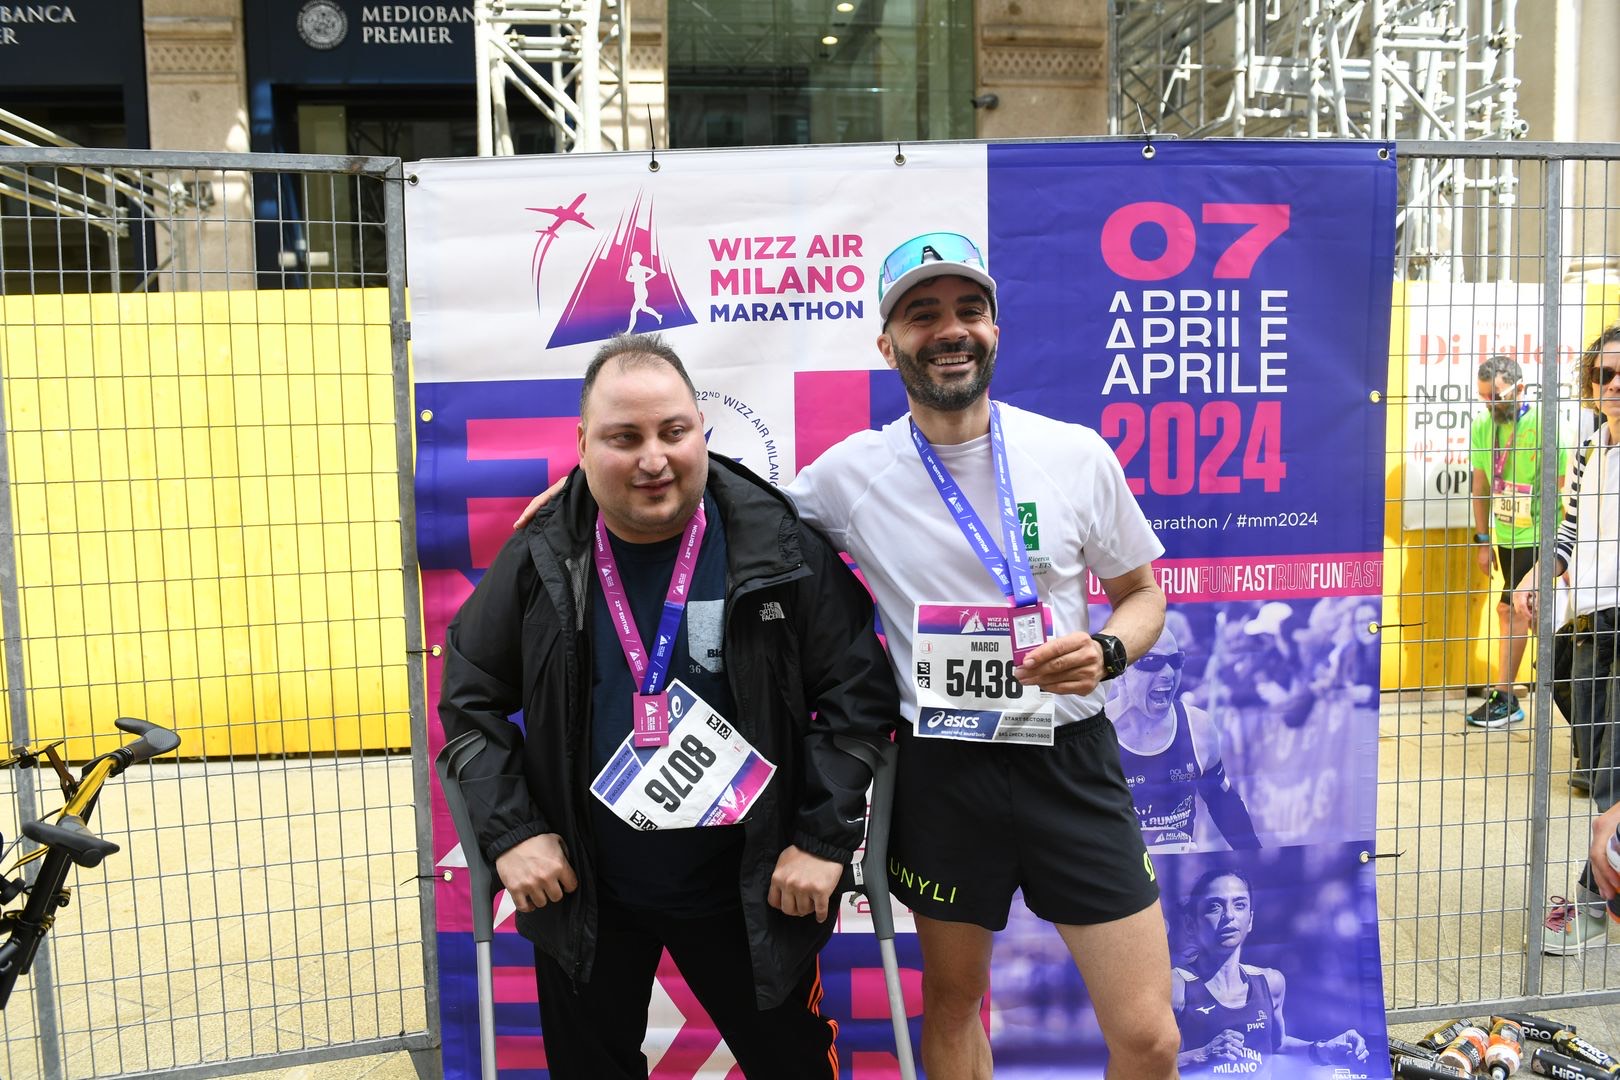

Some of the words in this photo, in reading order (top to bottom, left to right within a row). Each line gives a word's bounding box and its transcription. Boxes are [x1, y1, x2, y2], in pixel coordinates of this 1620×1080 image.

[362, 26, 453, 44] PREMIER
[708, 236, 797, 262] WIZZ
[806, 234, 863, 259] AIR
[1100, 201, 1290, 281] 07
[710, 264, 865, 297] MILANO
[710, 300, 864, 323] MARATHON
[1101, 352, 1288, 395] APRILE
[723, 395, 754, 419] WIZZ
[751, 418, 770, 438] AIR
[1100, 400, 1287, 495] 2024
[1147, 515, 1218, 530] arathon
[1236, 512, 1318, 528] #mm2024
[971, 641, 999, 653] MARCO
[689, 665, 701, 674] 36
[946, 658, 1024, 699] 5438
[644, 734, 717, 813] 8076
[1246, 1022, 1266, 1032] pwc
[1213, 1062, 1258, 1074] MILANO
